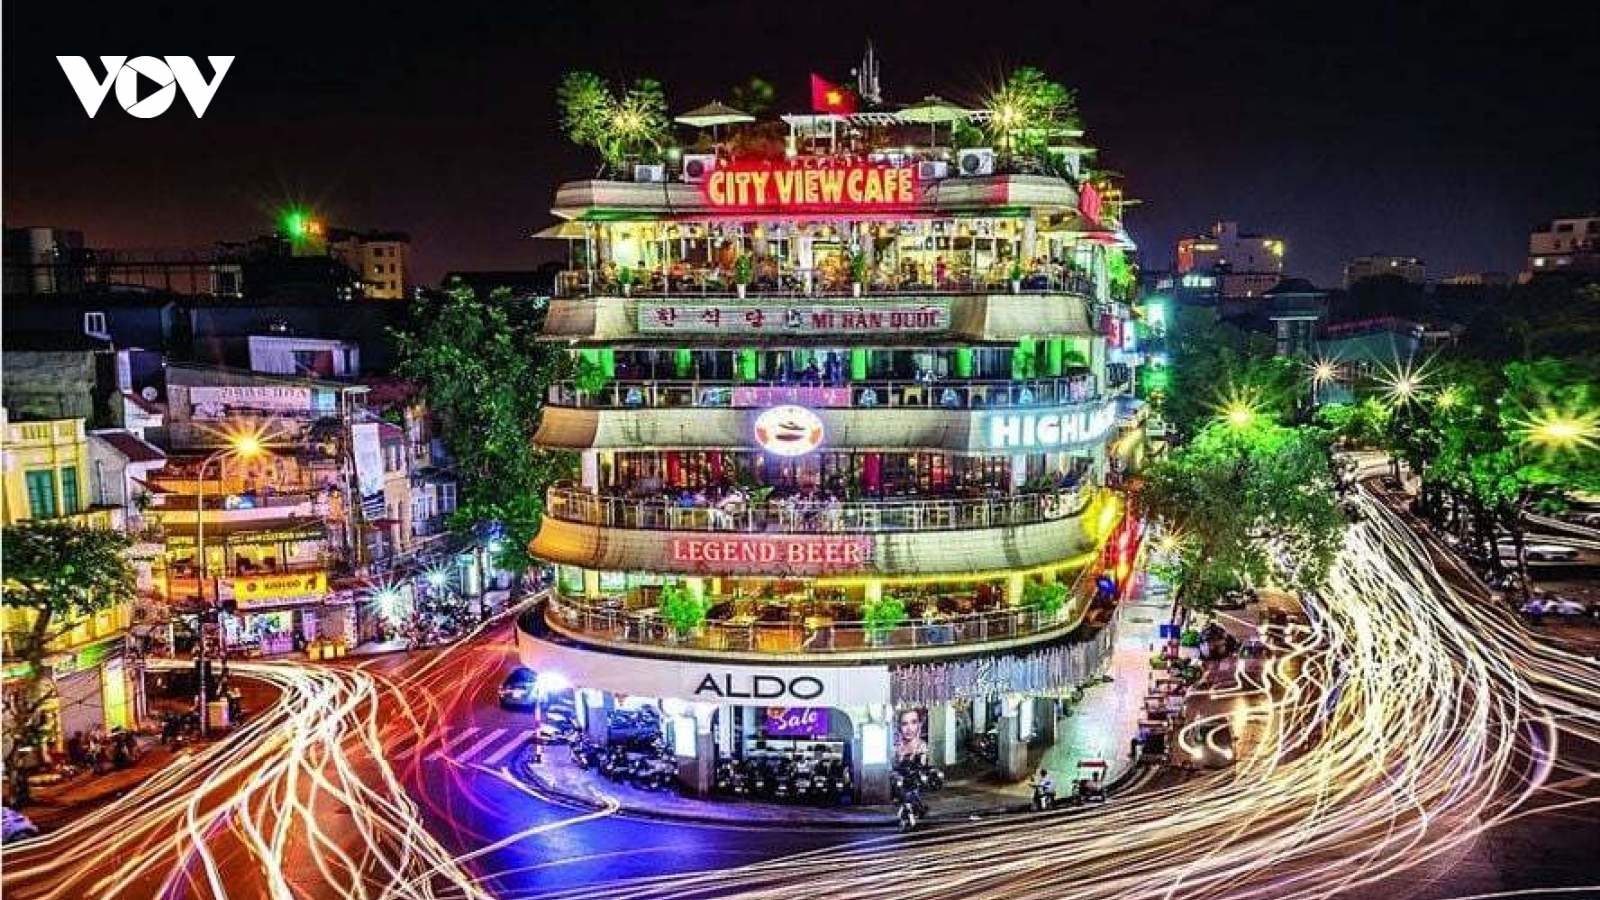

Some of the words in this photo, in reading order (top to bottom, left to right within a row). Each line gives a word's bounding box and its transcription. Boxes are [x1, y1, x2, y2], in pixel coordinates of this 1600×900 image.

[709, 171, 769, 206] CITY
[774, 168, 846, 205] VIEW
[847, 167, 914, 203] CAFE
[673, 539, 777, 564] LEGEND
[787, 542, 862, 564] BEER
[694, 673, 824, 699] ALDO
